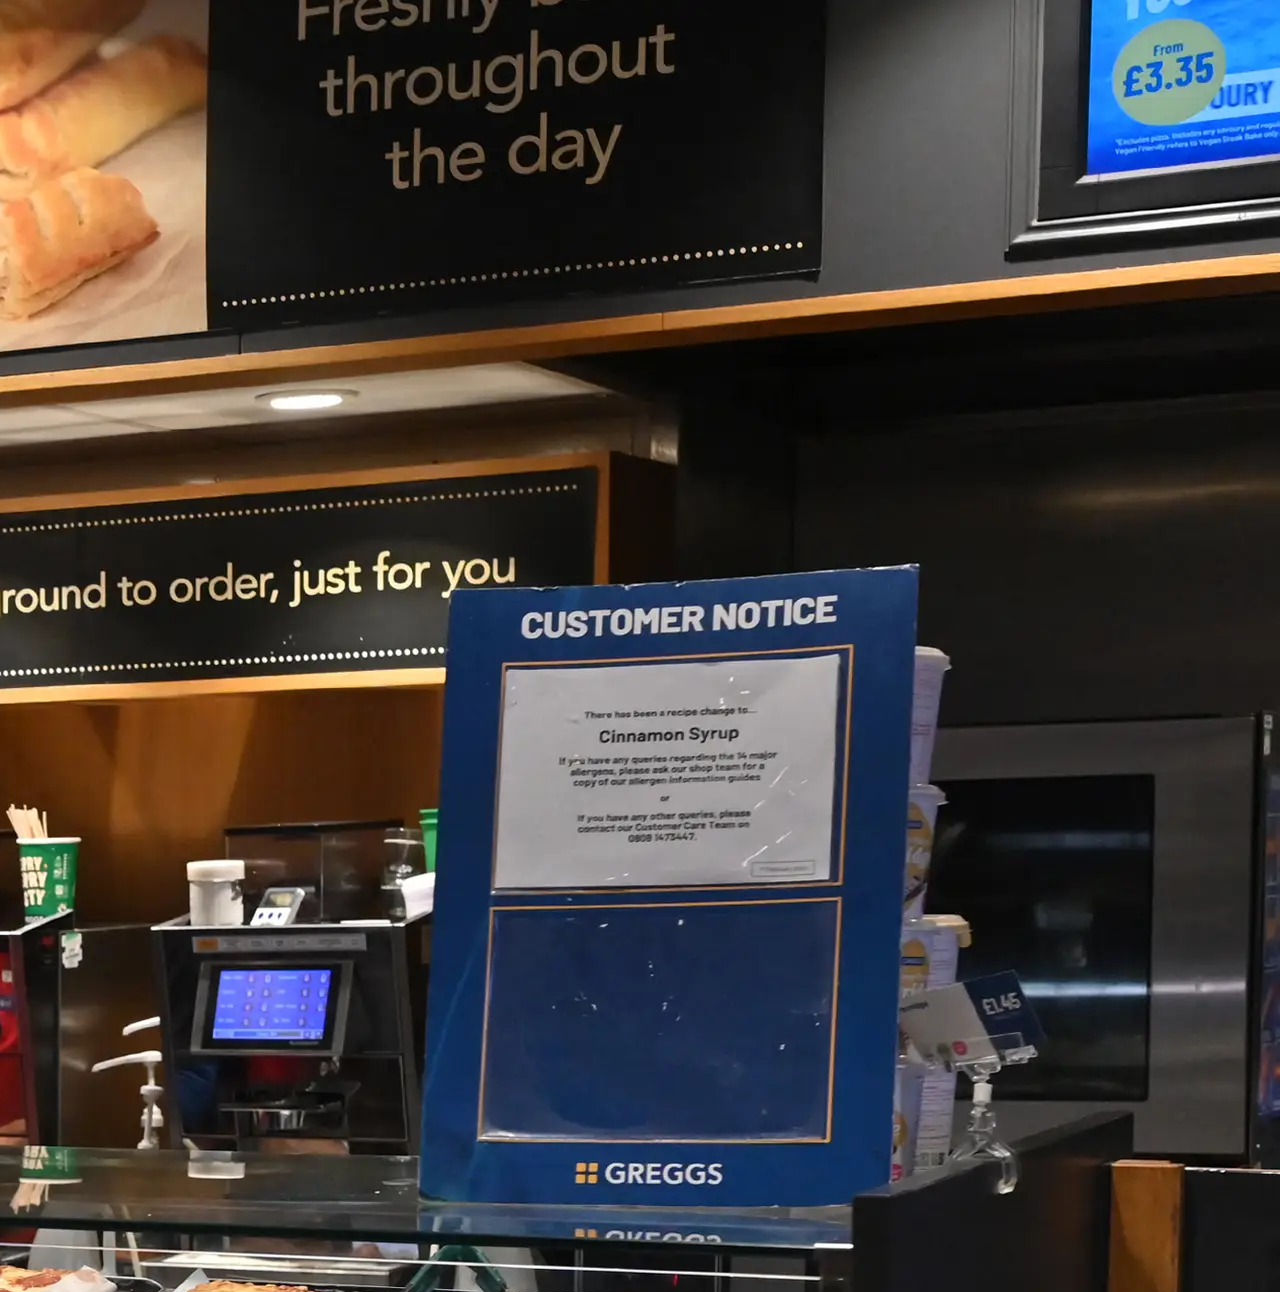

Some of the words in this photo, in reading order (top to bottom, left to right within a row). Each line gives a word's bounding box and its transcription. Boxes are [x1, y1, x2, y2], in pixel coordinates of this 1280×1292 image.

[297, 0, 497, 41] Fresy
[1153, 43, 1184, 56] From
[319, 24, 675, 116] throughout
[1123, 52, 1214, 98] £3.35
[385, 128, 486, 190] the
[507, 112, 623, 185] day
[117, 576, 156, 607] to
[169, 562, 279, 603] order,
[289, 560, 362, 607] just
[373, 551, 431, 592] for
[441, 557, 516, 599] you
[520, 605, 704, 640] CUSTOMER
[711, 594, 839, 632] NOTICE
[584, 711, 612, 719] There
[633, 710, 657, 718] been
[667, 708, 698, 718] recipe
[700, 707, 735, 716] change
[599, 729, 684, 744] Cinnamon
[689, 727, 739, 743] Syrup
[559, 757, 566, 765] If
[587, 756, 610, 765] have
[612, 757, 630, 766] any
[632, 755, 667, 765] queries
[669, 753, 716, 763] regarding
[719, 753, 735, 761] the
[749, 751, 777, 761] major
[570, 768, 617, 777] allergens,
[619, 766, 650, 776] please
[652, 765, 669, 774] ask
[689, 764, 713, 774] shop
[716, 763, 740, 772] team
[743, 762, 756, 771] for
[604, 1161, 723, 1186] GREGGS
